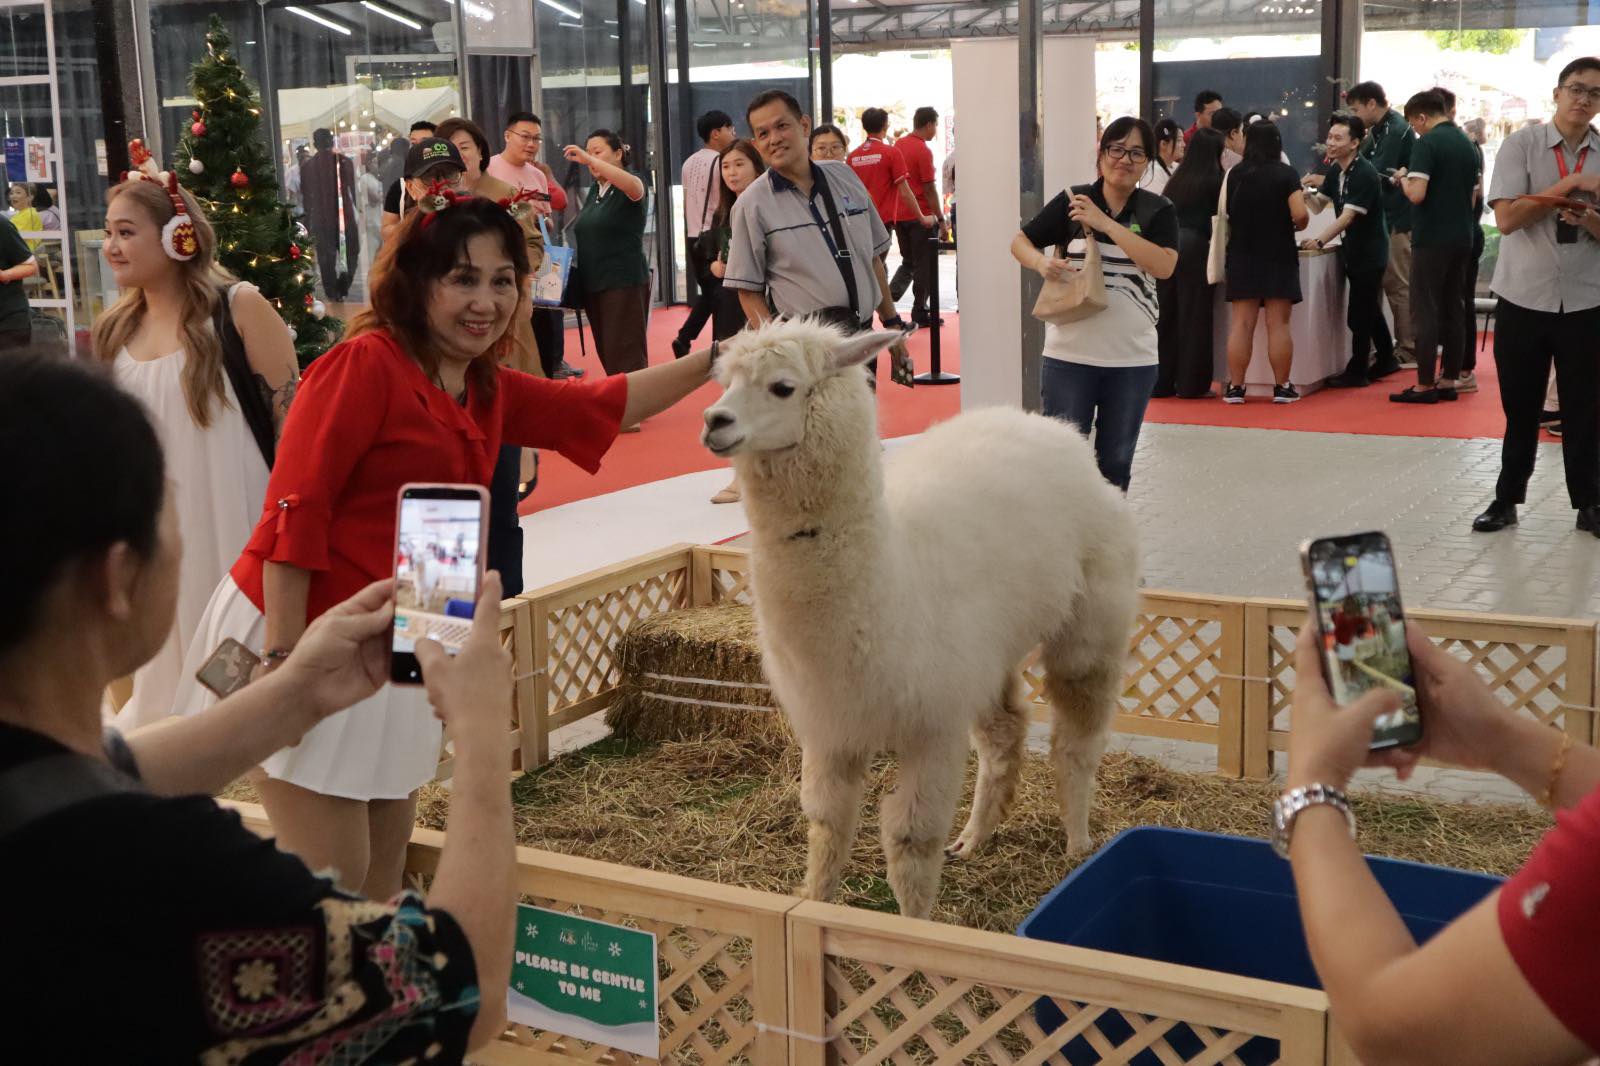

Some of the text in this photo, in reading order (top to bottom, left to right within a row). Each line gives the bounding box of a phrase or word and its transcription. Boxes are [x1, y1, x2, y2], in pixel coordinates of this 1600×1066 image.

[515, 950, 645, 993] PLEASE BE GENTLE
[558, 980, 601, 1002] TO ME
